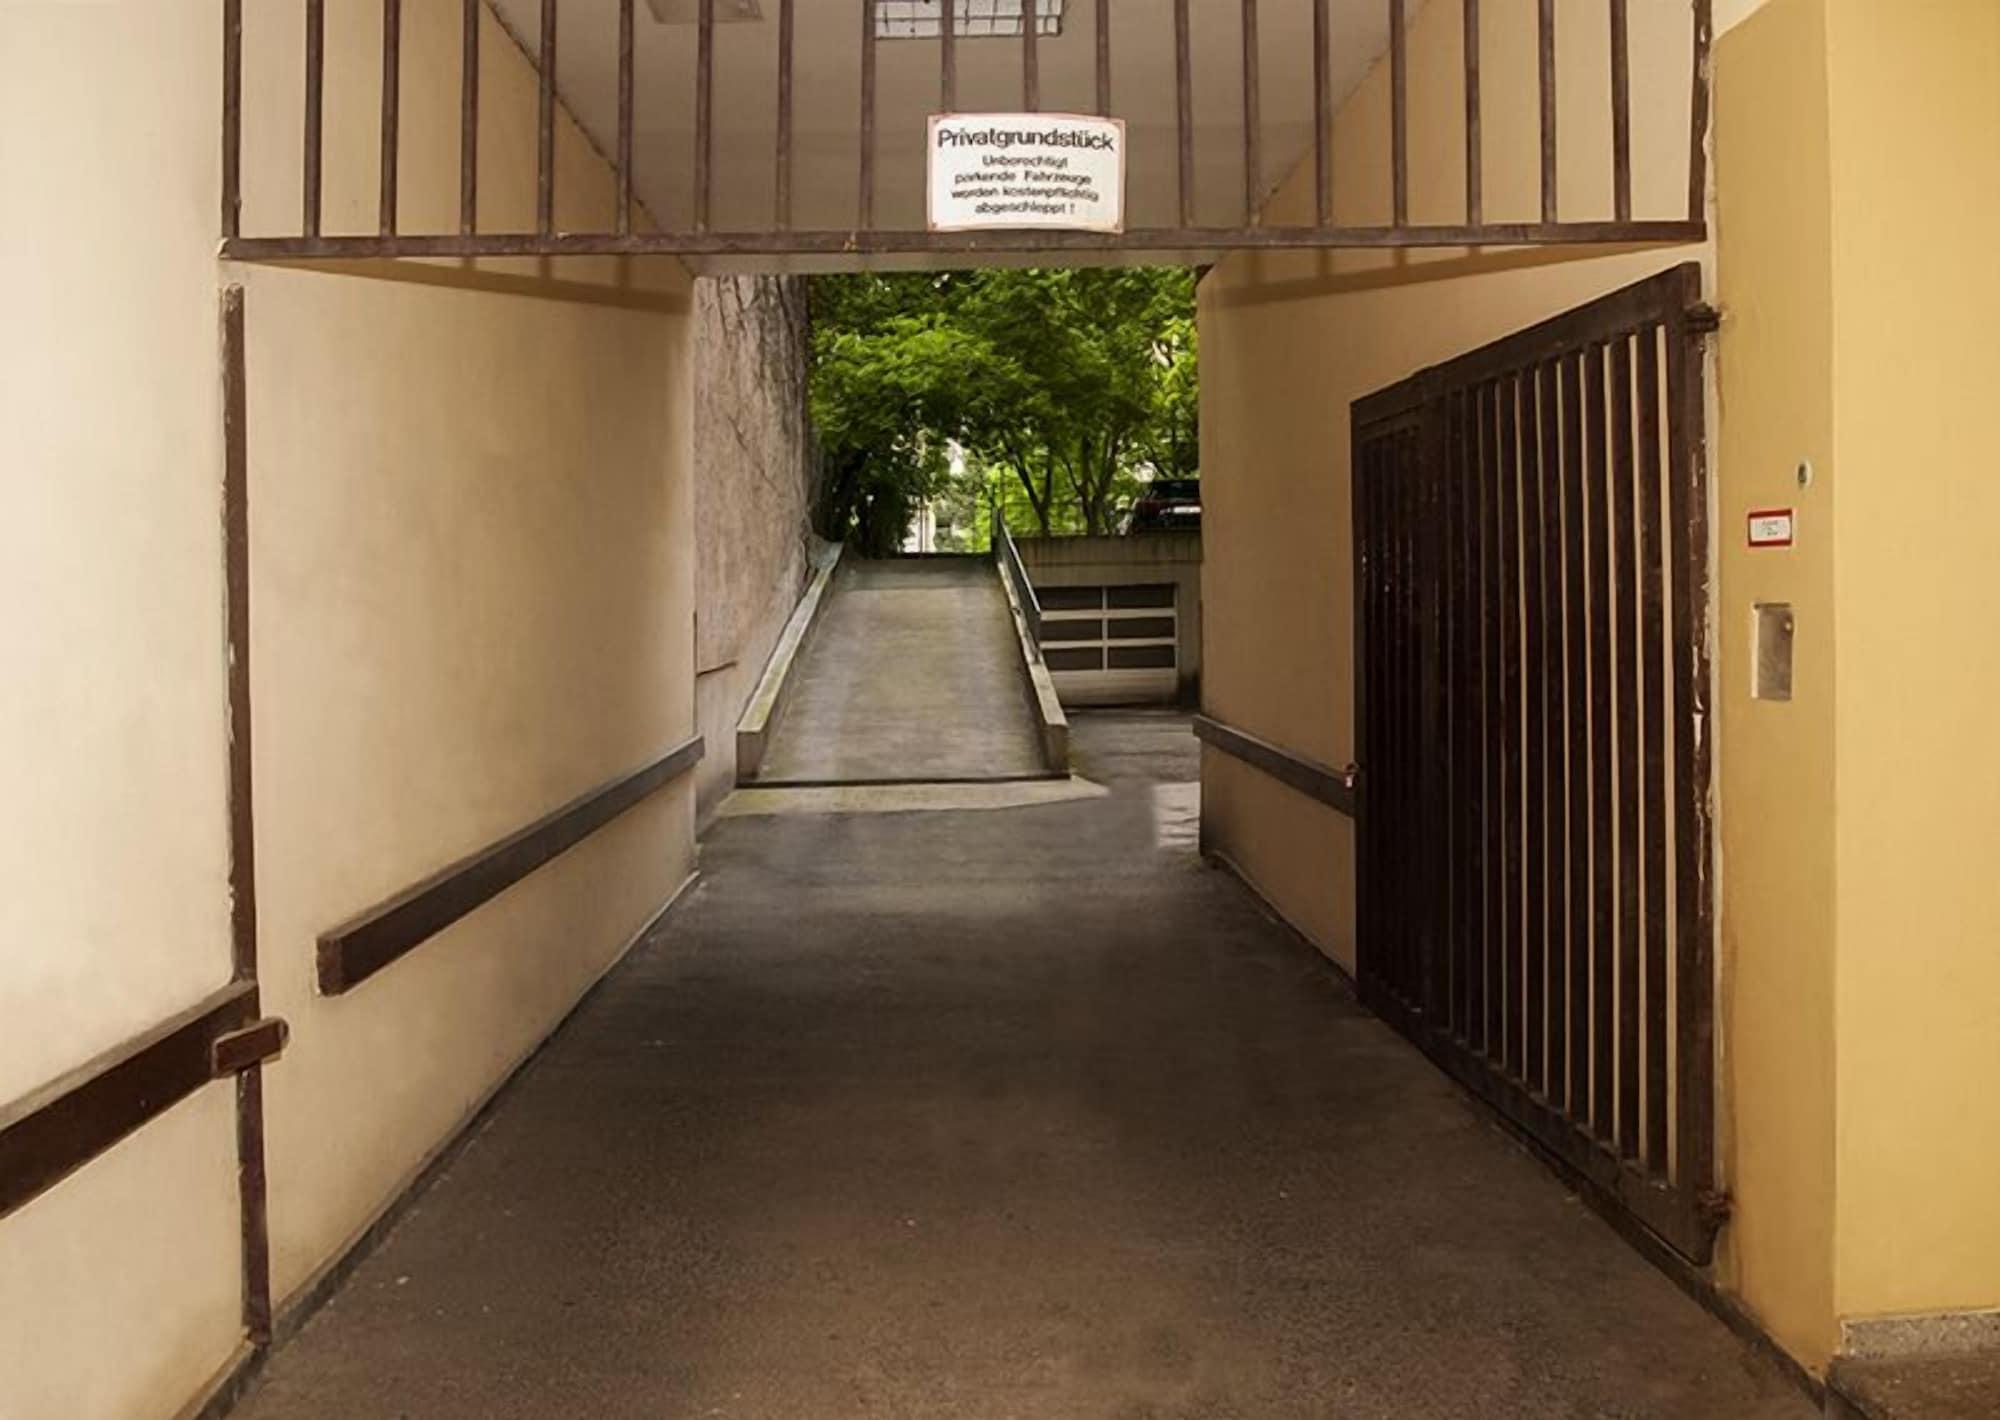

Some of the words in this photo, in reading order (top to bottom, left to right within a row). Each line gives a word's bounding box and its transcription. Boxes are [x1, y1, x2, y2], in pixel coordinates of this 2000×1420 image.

[938, 128, 1114, 151] Privatgrundstück
[982, 155, 1068, 168] Unberechtigt
[955, 171, 1016, 184] parkende
[1024, 171, 1092, 186] Fahrzeuge
[951, 187, 998, 199] werden
[1003, 187, 1099, 202] kostenpflichtig
[975, 202, 1066, 214] abgeschleppt
